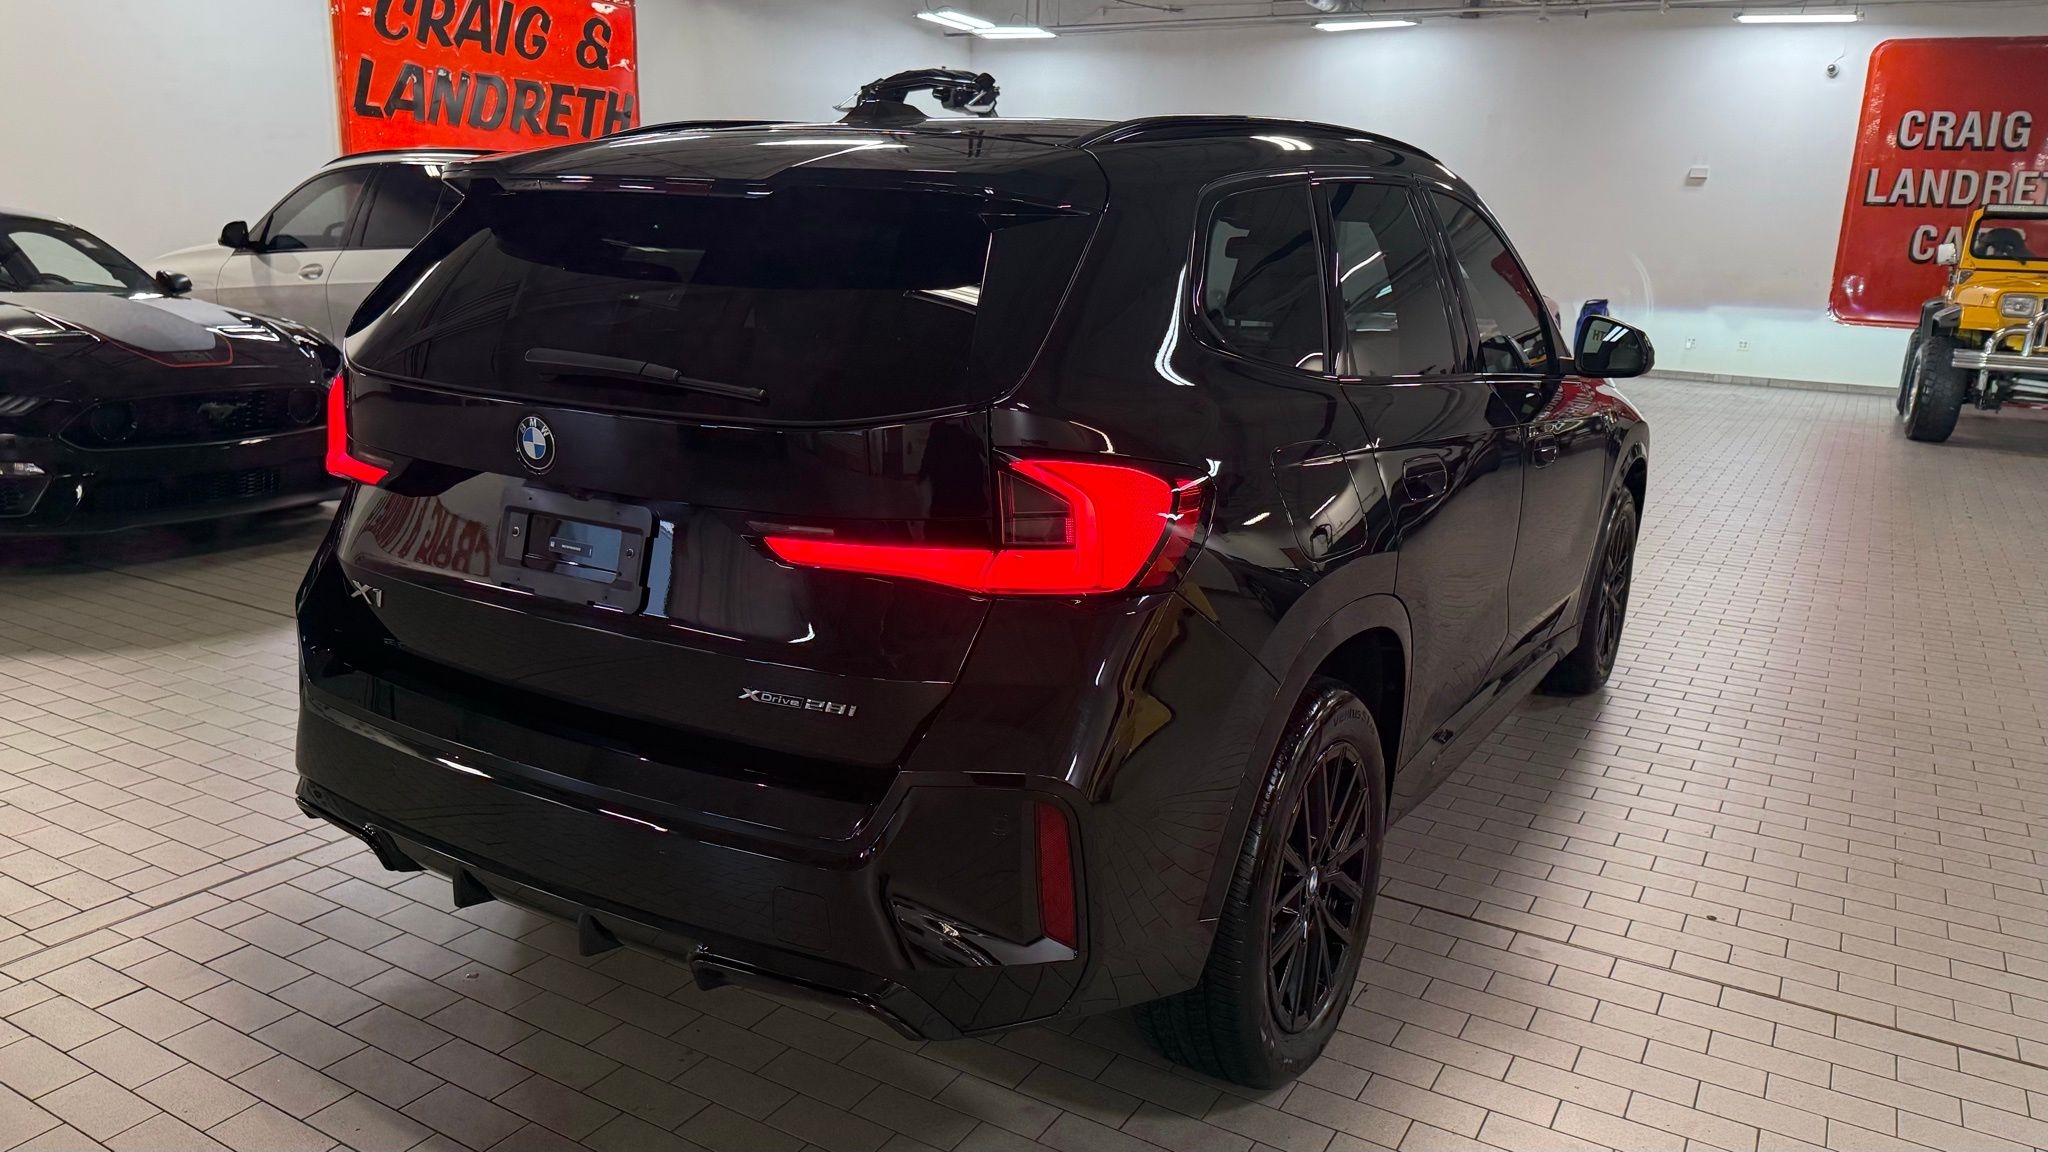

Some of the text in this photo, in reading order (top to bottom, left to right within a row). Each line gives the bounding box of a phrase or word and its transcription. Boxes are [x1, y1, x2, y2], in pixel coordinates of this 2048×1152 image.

[373, 0, 609, 70] CRAIG &
[354, 58, 634, 139] LANDRETH
[1898, 110, 2033, 150] CRAIG
[519, 417, 551, 437] BMW
[351, 579, 382, 608] X1
